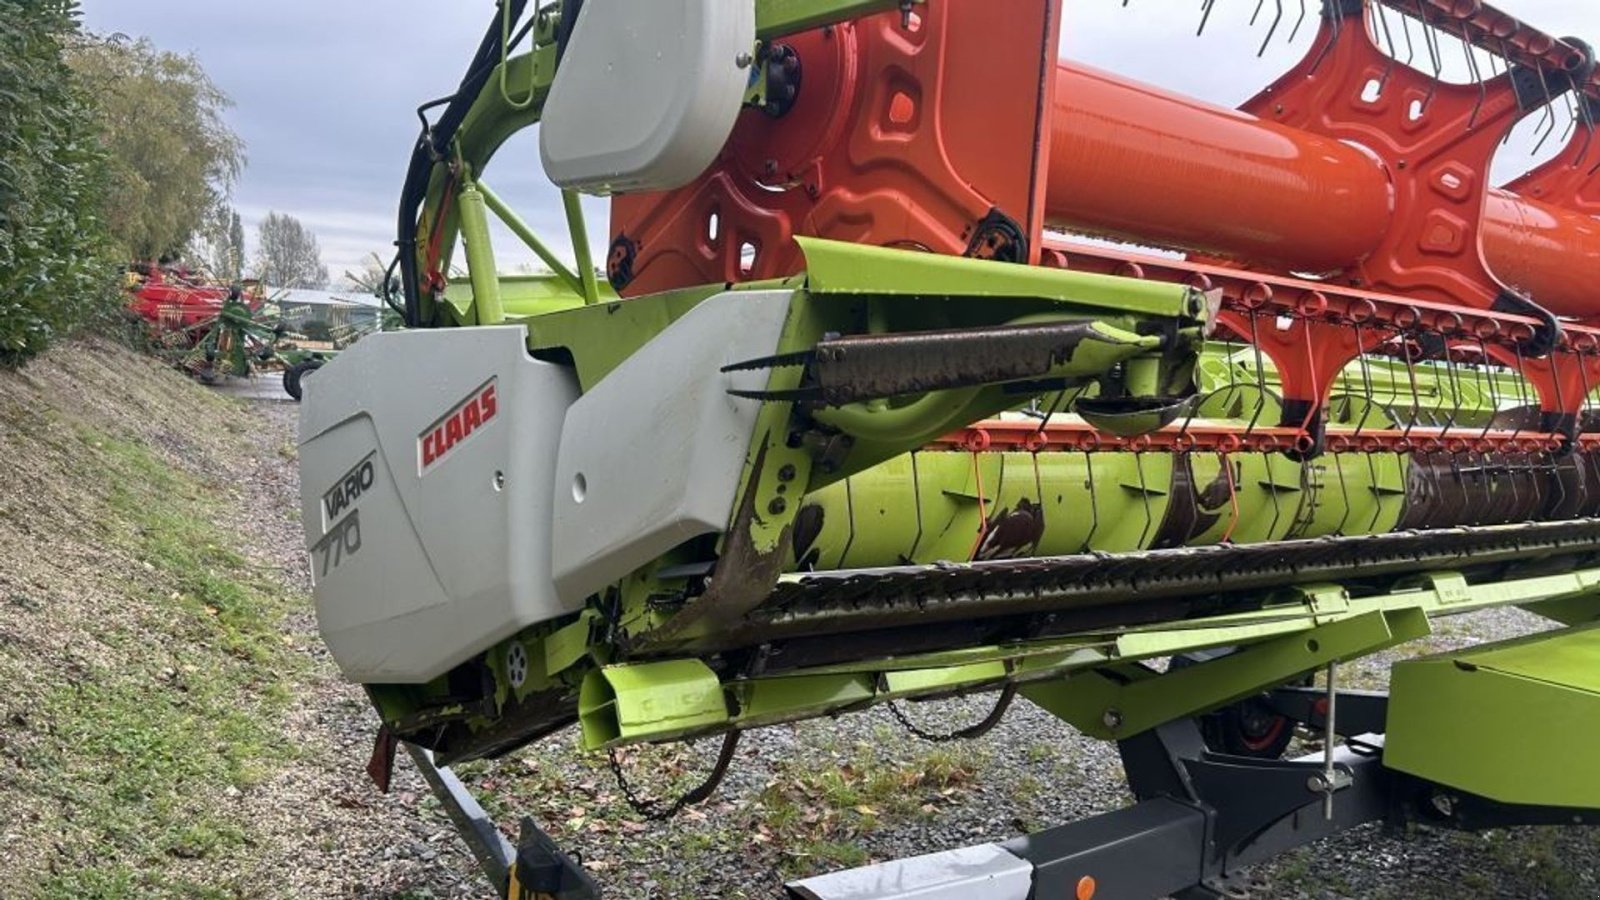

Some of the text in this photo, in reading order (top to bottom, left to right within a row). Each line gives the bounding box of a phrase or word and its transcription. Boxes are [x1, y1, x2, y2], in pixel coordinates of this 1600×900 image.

[422, 384, 497, 468] CLAAS
[324, 460, 374, 520] VARIO
[318, 518, 362, 577] 770
